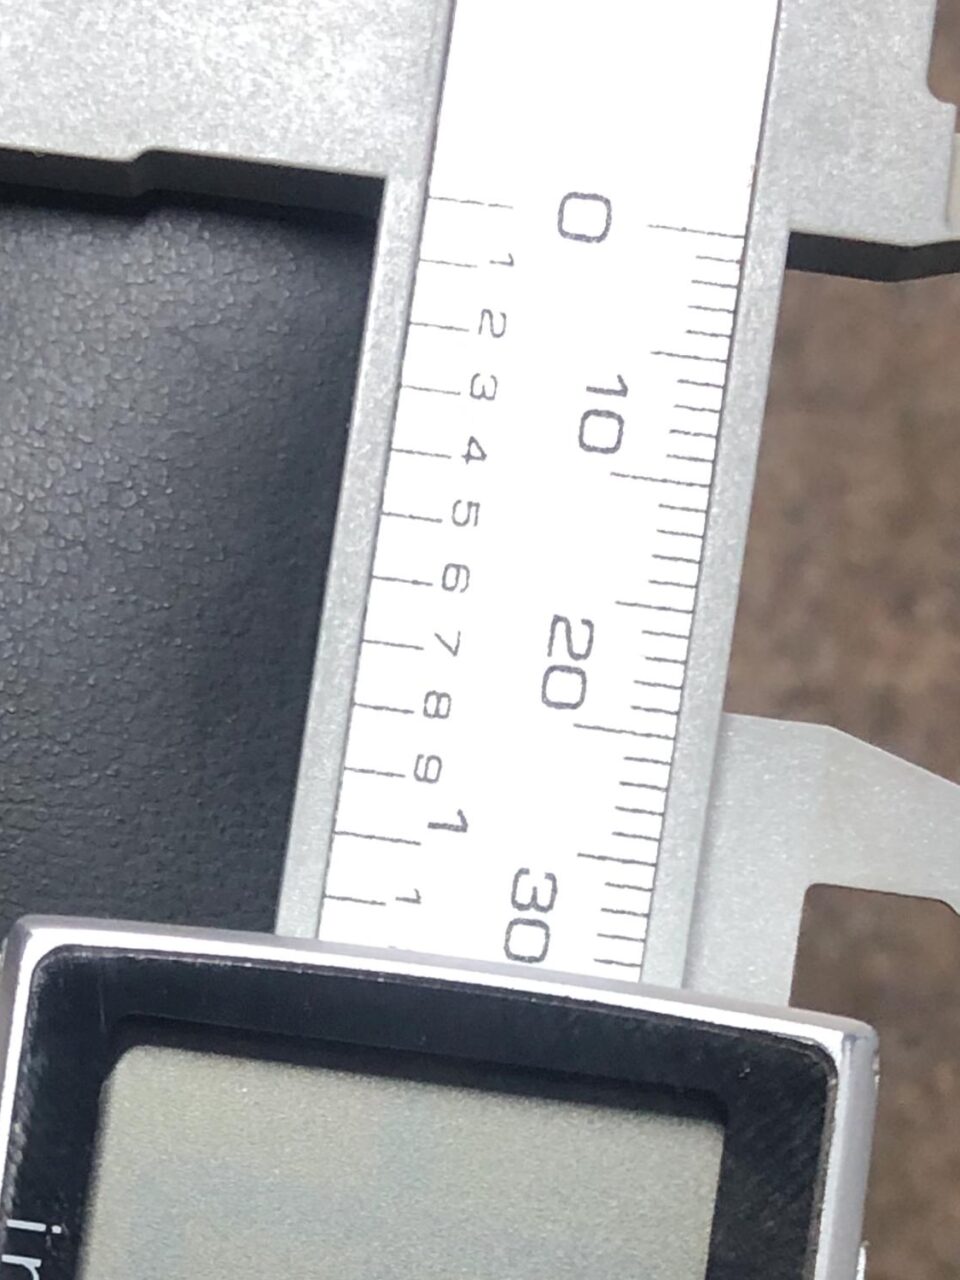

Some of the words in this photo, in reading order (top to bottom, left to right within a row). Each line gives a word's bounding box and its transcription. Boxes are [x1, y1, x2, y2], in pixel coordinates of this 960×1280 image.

[558, 192, 611, 243] 0
[491, 254, 513, 266] 1
[479, 309, 506, 338] 2
[470, 373, 497, 400] 3
[579, 375, 628, 454] 10
[462, 436, 487, 464] 4
[453, 500, 480, 526] 5
[442, 564, 469, 592] 6
[435, 632, 460, 656] 7
[542, 615, 594, 709] 20
[424, 691, 451, 719] 8
[414, 755, 442, 783] 9
[428, 810, 468, 832] 1
[396, 890, 420, 904] 1
[504, 868, 557, 963] 30
